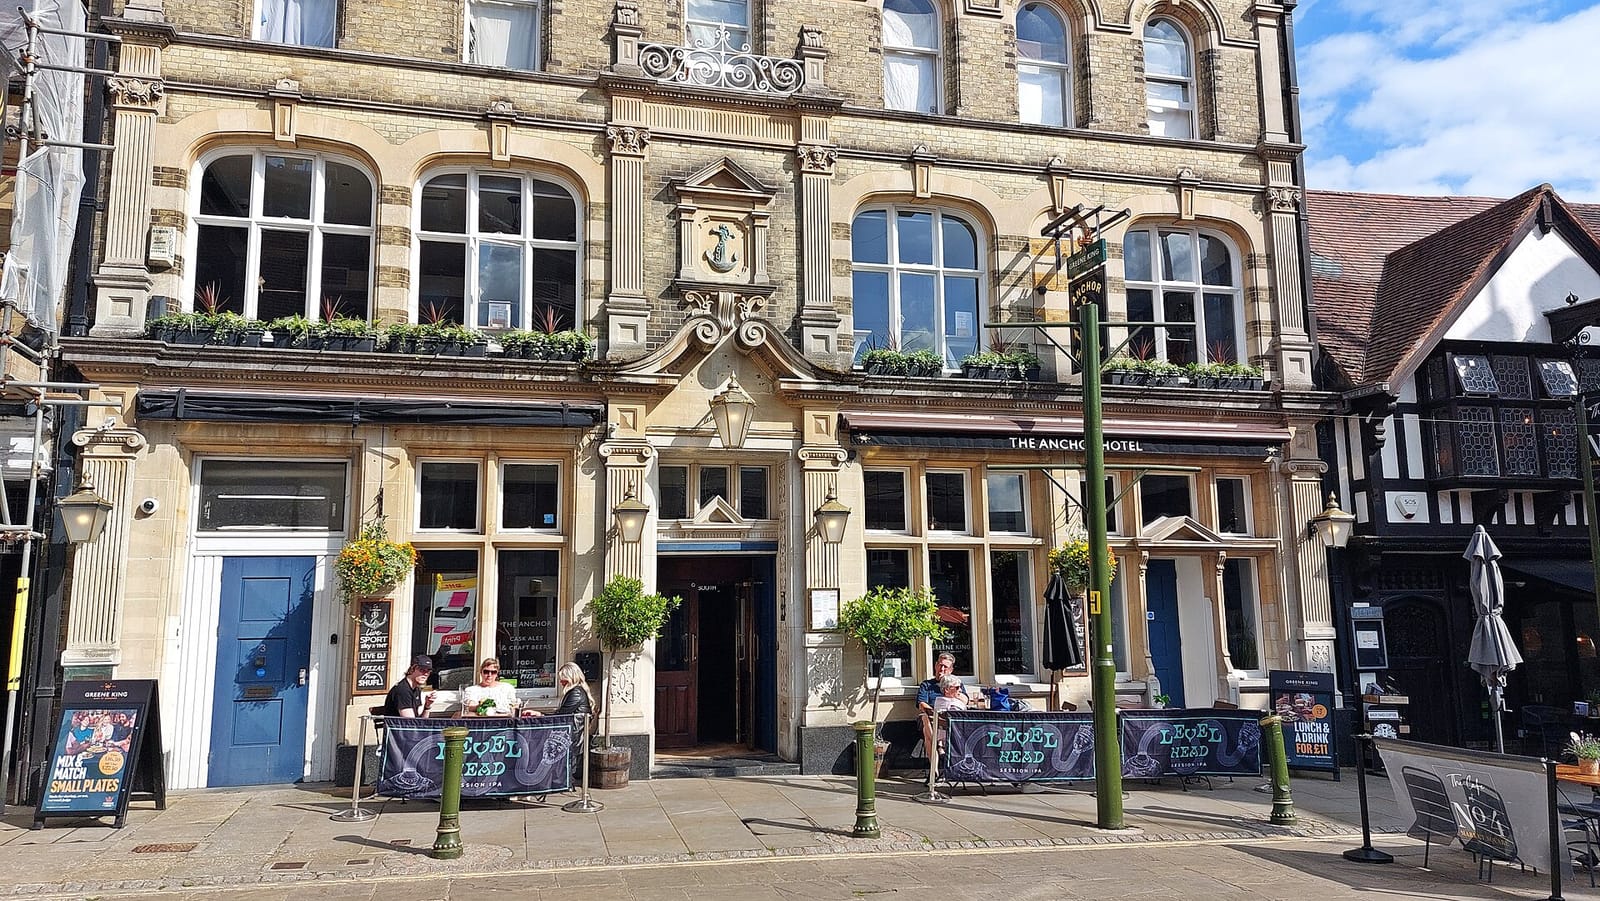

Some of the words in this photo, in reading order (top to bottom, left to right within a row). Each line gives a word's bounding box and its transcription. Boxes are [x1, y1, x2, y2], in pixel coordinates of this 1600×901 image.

[1087, 248, 1100, 259] KING
[1071, 280, 1102, 306] ANCHOR
[1009, 437, 1035, 449] THE
[1039, 438, 1085, 450] ANCHO
[360, 636, 388, 644] SPORT
[259, 643, 266, 653] 3
[1294, 721, 1322, 733] LUNCH
[1323, 722, 1330, 733] &
[986, 727, 1058, 748] LEVEL
[1160, 723, 1222, 745] LEVEL
[1295, 732, 1302, 743] A
[1302, 733, 1329, 744] DRINK
[1170, 745, 1209, 758] HEAD
[1296, 743, 1313, 754] FOR
[1313, 744, 1329, 755] £11
[56, 755, 75, 768] MIX
[75, 754, 83, 768] &
[999, 750, 1045, 763] HEAD
[53, 767, 87, 780] MATCH
[461, 761, 506, 777] EAD
[50, 780, 82, 793] SMALL
[82, 778, 120, 792] PLATES
